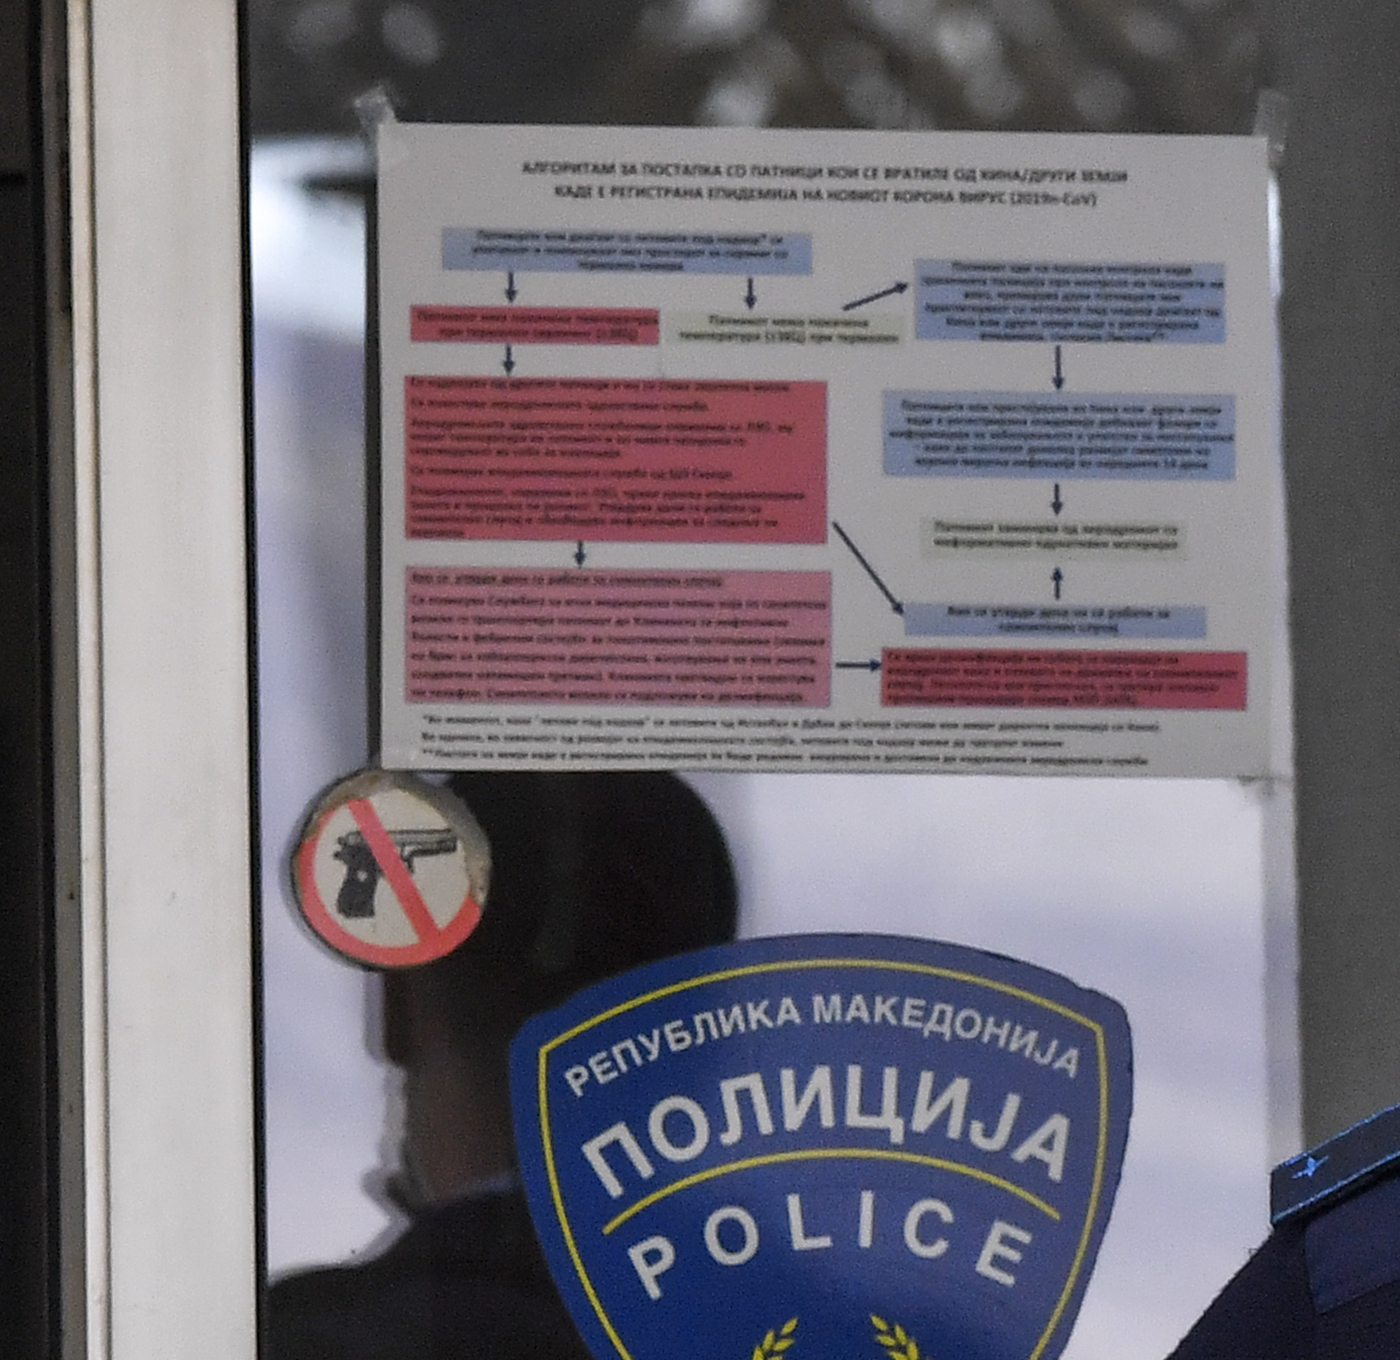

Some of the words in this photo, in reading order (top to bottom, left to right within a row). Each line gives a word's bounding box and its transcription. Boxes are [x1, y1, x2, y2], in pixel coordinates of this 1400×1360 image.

[641, 161, 723, 178] ПОСТАПКА
[564, 996, 801, 1098] РЕПУБЛИКА
[812, 993, 1081, 1079] МАКЕДОНИЈА
[581, 1064, 1074, 1200] ПОЛИЦИЈА
[627, 1189, 1033, 1301] POLICE
